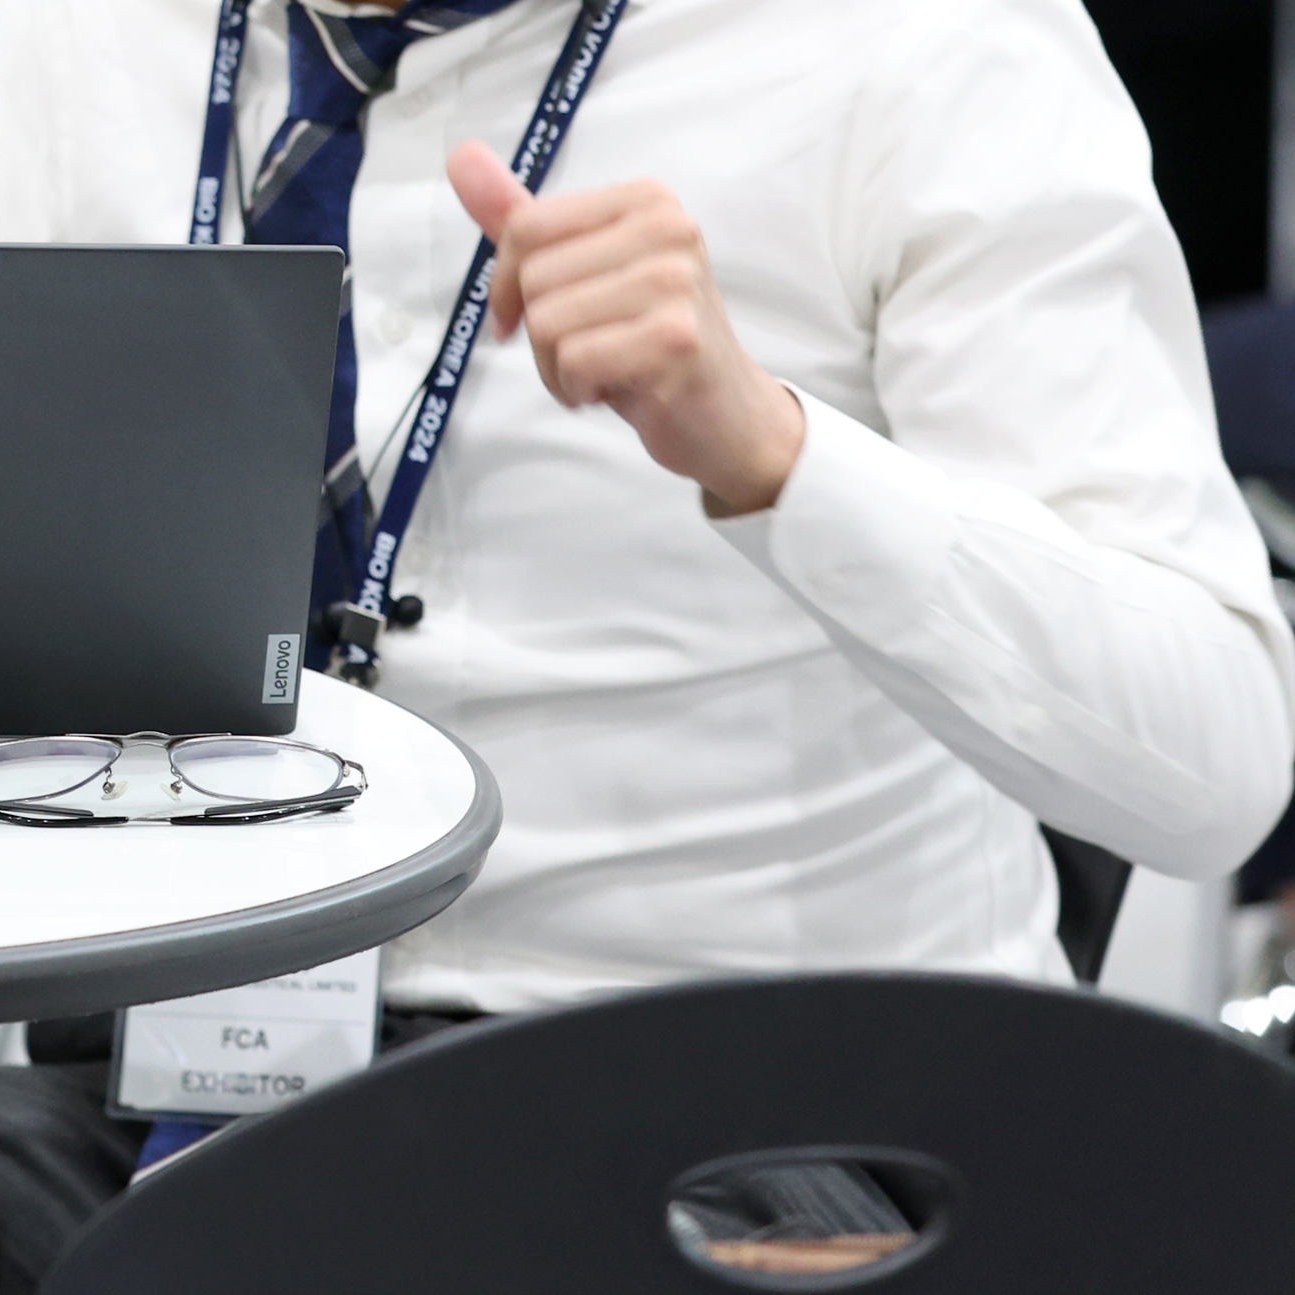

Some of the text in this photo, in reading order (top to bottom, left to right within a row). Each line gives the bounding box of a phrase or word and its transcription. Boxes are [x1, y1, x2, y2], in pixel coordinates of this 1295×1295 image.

[212, 37, 241, 104] 2024
[195, 176, 220, 225] BIO
[435, 301, 482, 388] KOREA
[408, 393, 448, 464] 2024
[368, 531, 397, 580] BIO
[270, 640, 291, 698] Lenovo
[220, 1026, 270, 1051] FCA
